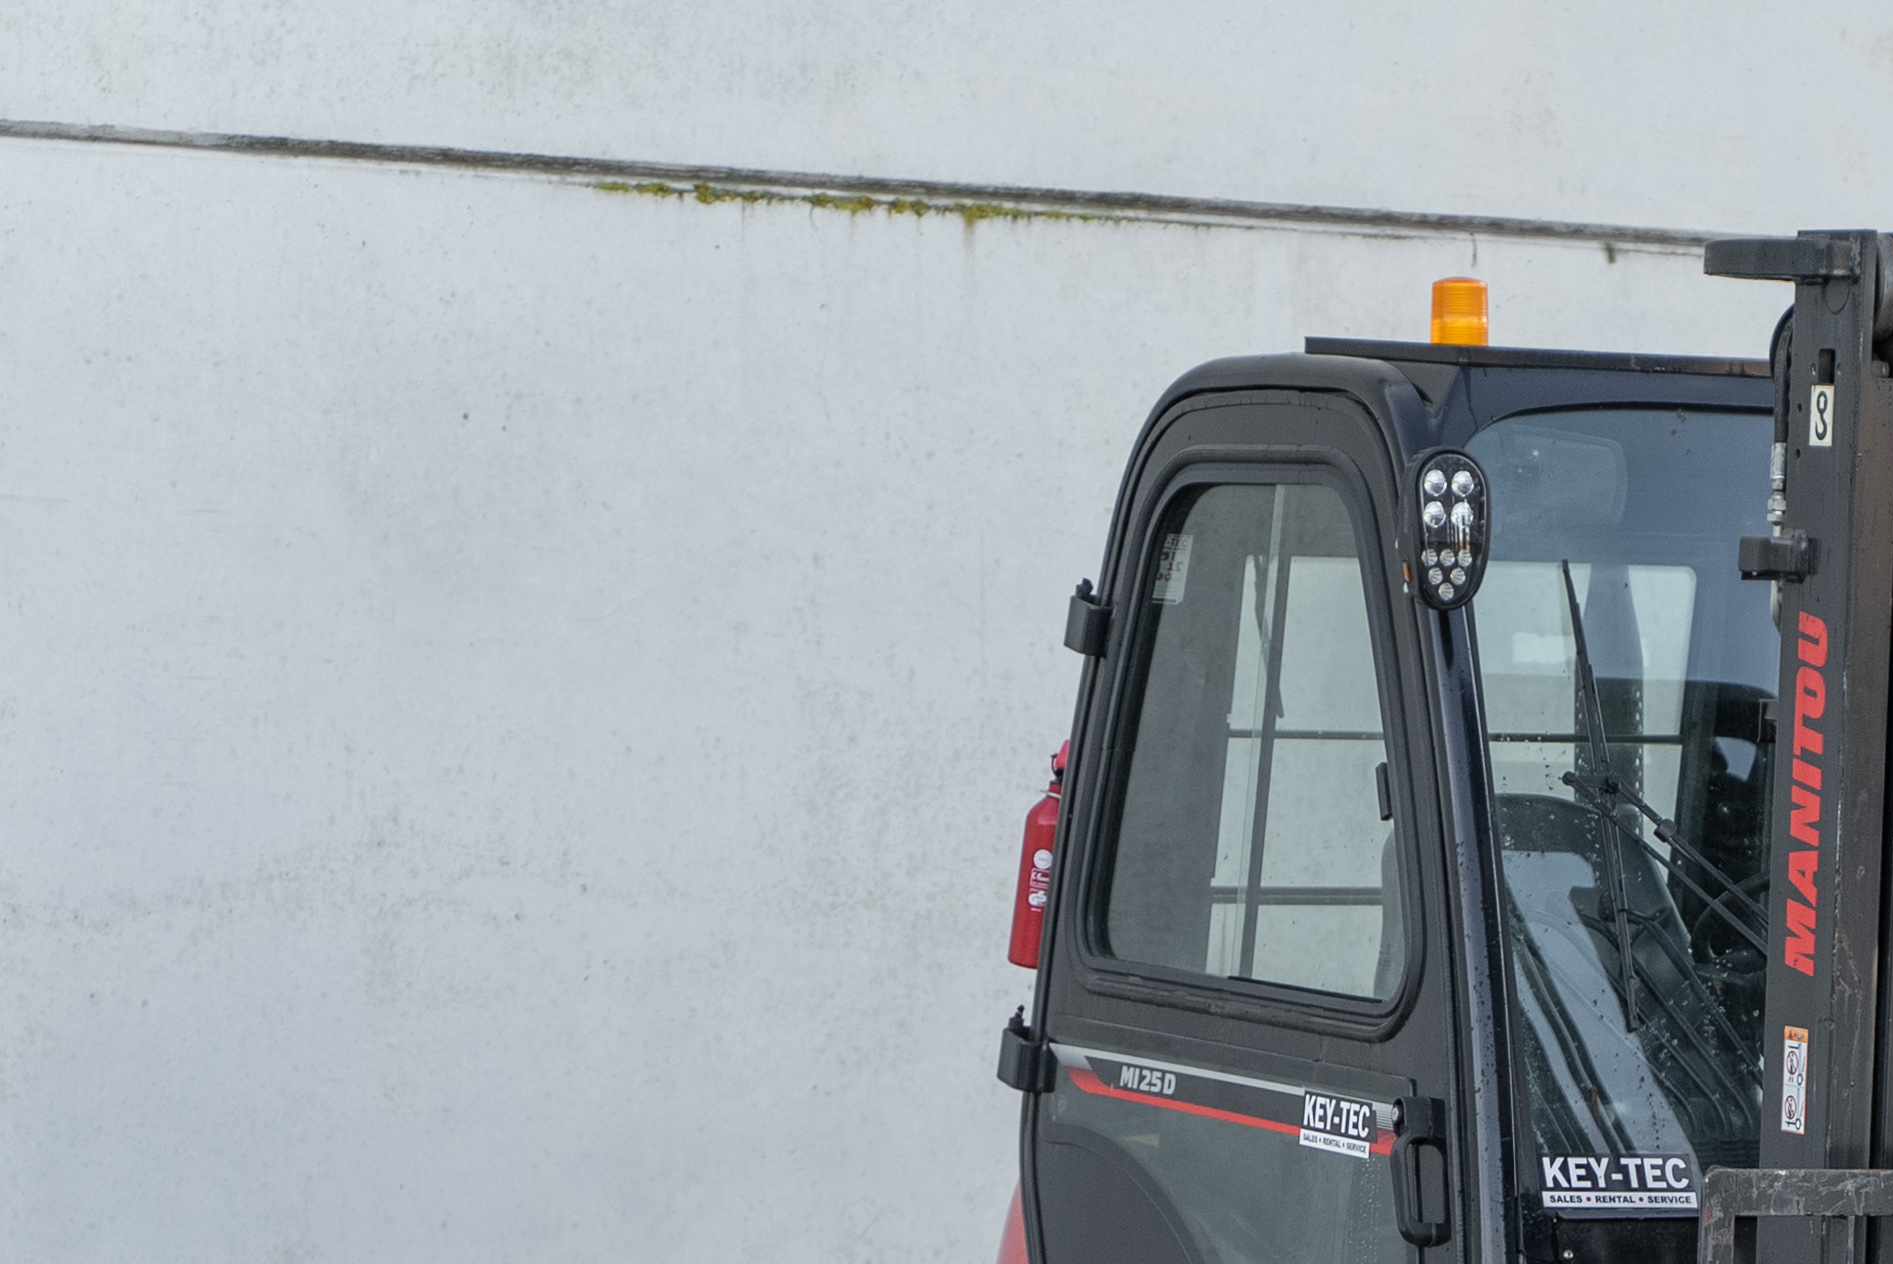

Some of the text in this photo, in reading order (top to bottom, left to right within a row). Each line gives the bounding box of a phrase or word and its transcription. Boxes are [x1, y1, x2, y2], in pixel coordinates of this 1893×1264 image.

[1785, 611, 1828, 977] MANITOU
[1303, 1094, 1370, 1138] KEY-TEC
[1323, 1137, 1341, 1148] RENTAL
[1346, 1142, 1367, 1154] SERVICE
[1542, 1157, 1690, 1189] KEY-TEC
[1549, 1195, 1692, 1204] SALES RENTAL SERVICE
